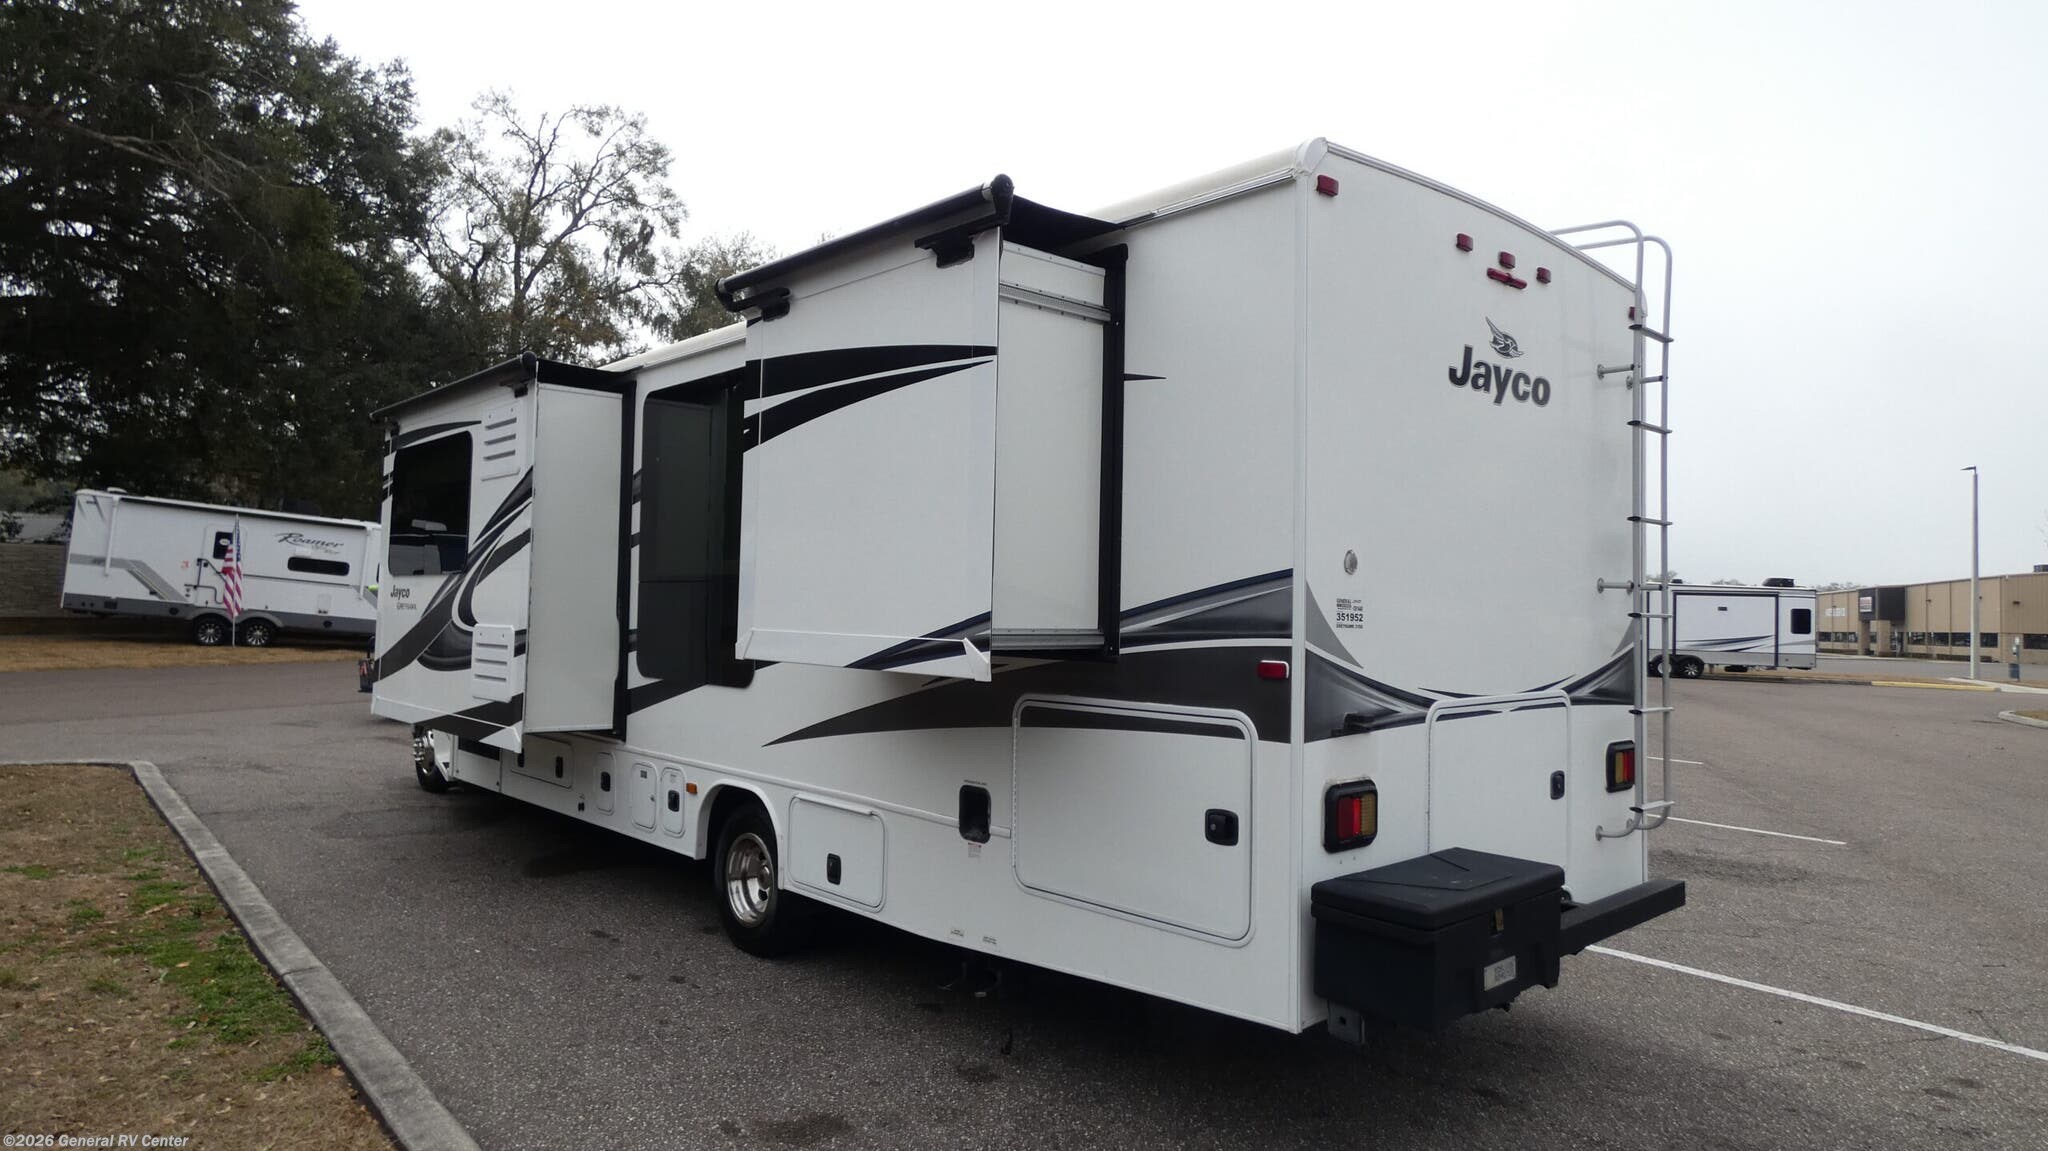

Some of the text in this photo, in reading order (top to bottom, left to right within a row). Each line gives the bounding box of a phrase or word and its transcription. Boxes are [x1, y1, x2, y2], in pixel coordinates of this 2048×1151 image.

[1448, 344, 1551, 407] Jayco
[276, 532, 344, 548] Roamer
[390, 584, 410, 600] Jayco
[1336, 612, 1363, 622] 351952
